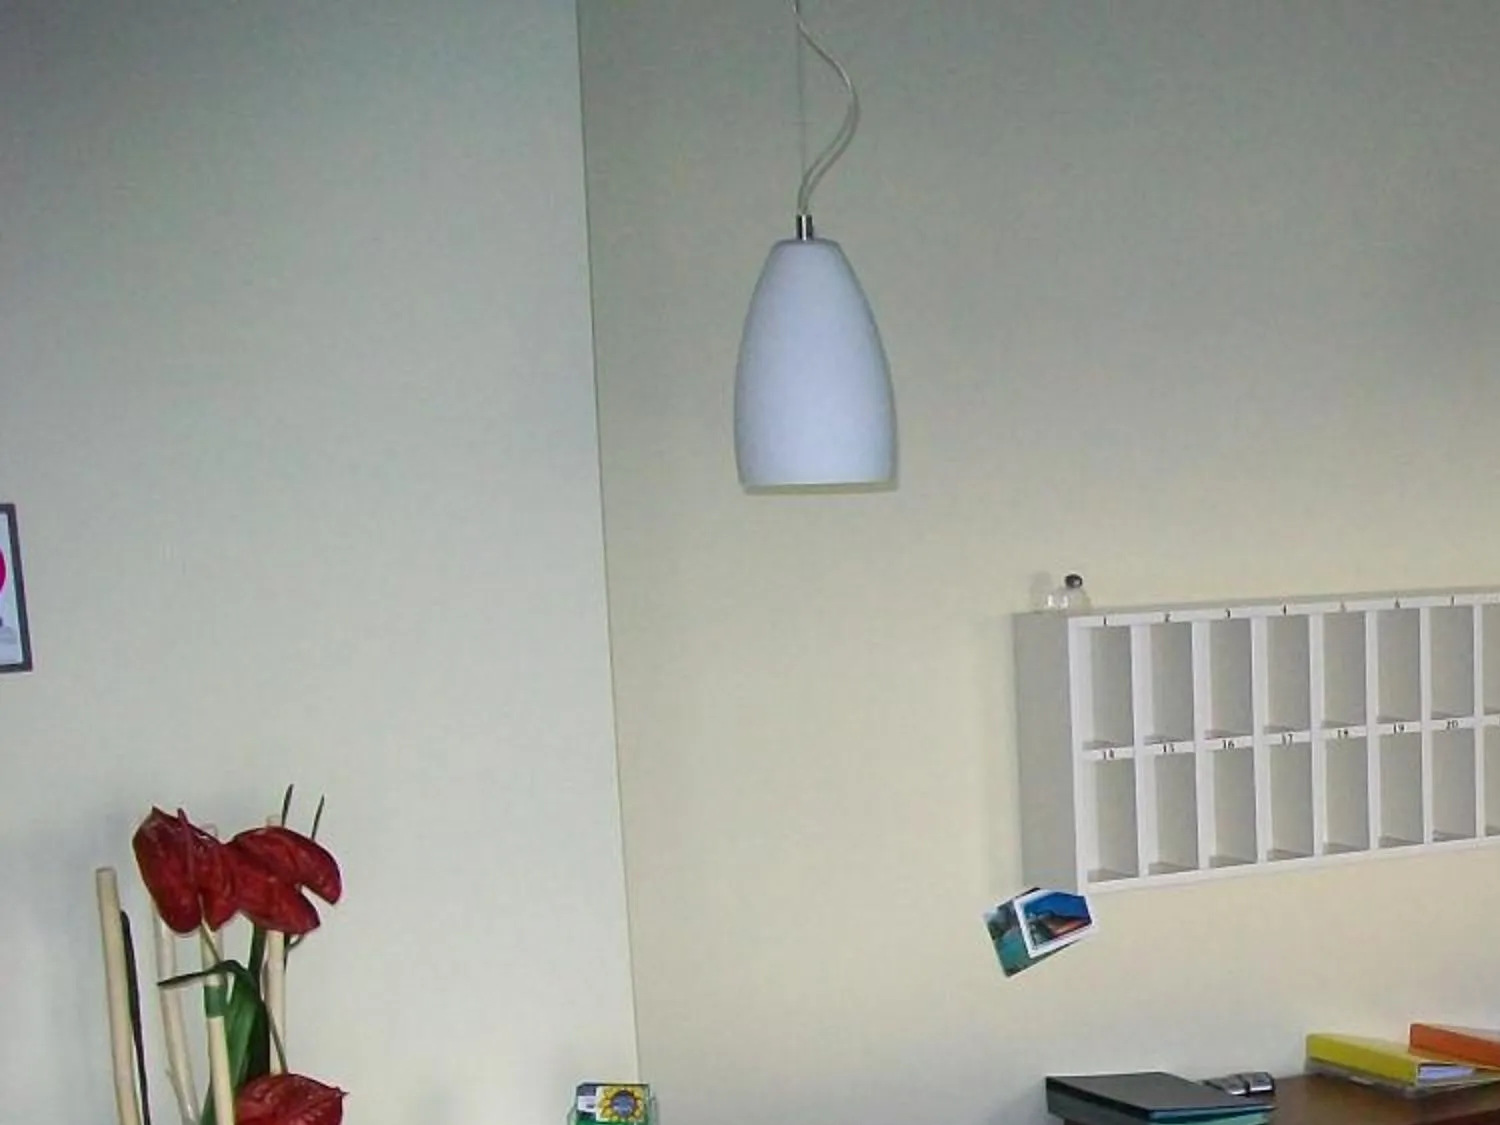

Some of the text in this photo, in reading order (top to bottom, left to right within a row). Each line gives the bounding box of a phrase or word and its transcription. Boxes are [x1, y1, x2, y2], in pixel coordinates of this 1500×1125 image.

[1445, 719, 1459, 730] 20
[1221, 740, 1235, 749] 16
[1281, 734, 1294, 745] 17
